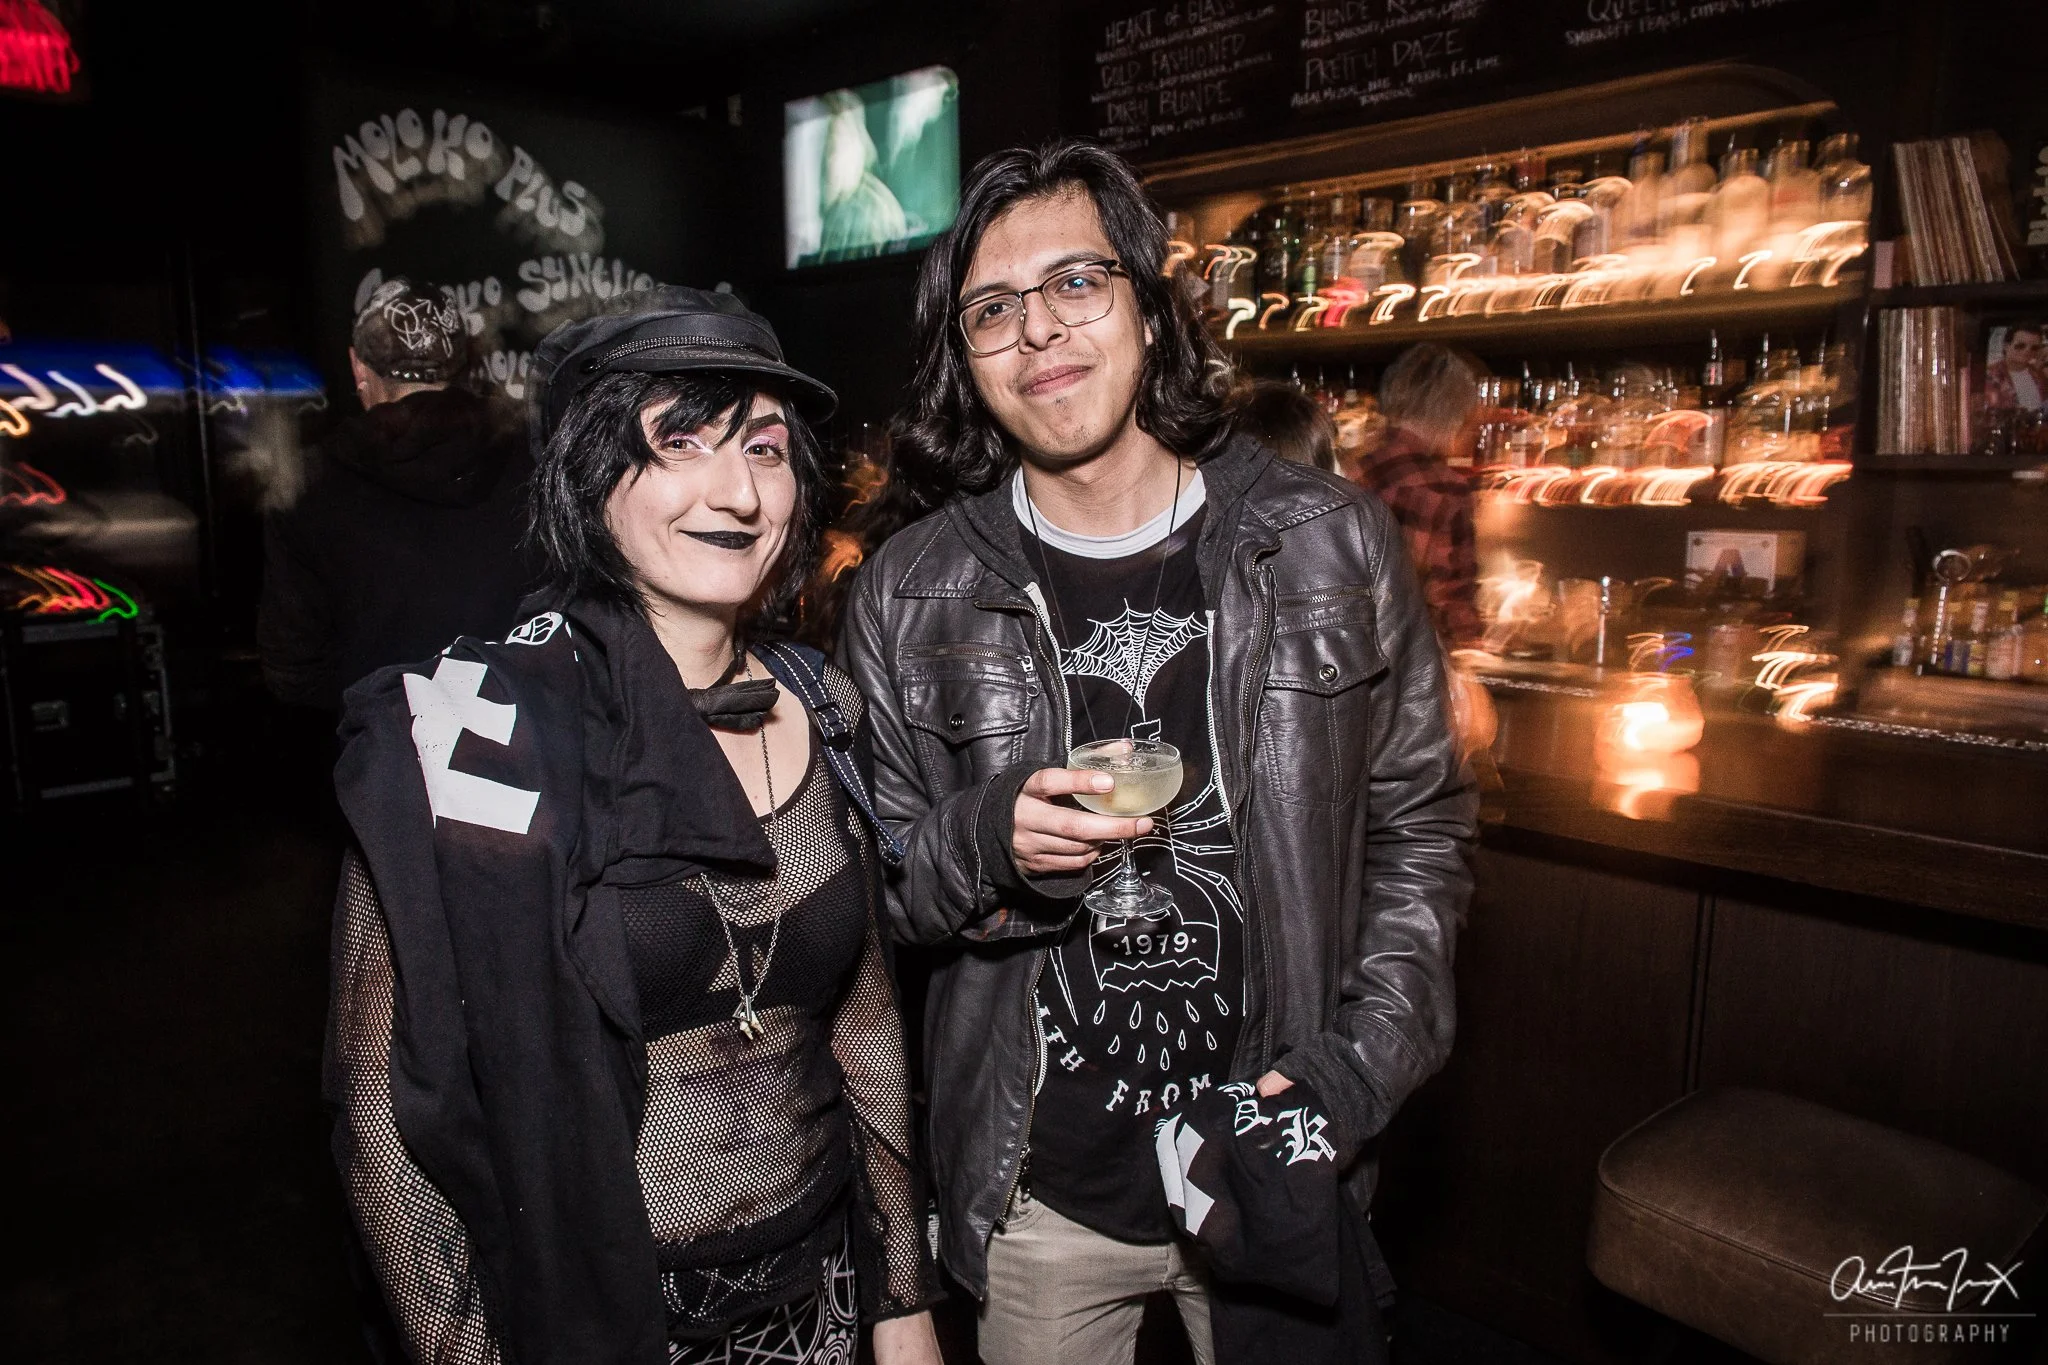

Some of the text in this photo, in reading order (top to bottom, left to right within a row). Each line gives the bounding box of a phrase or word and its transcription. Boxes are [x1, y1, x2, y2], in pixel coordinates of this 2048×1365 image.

[1105, 8, 1156, 47] HEART
[1305, 47, 1378, 90] PRETTY
[1392, 28, 1464, 69] DAZE
[1159, 79, 1232, 116] BLONDE
[333, 108, 587, 237] MOLOKO PLUS
[1120, 931, 1189, 955] 1979
[1105, 1073, 1211, 1115] FROM
